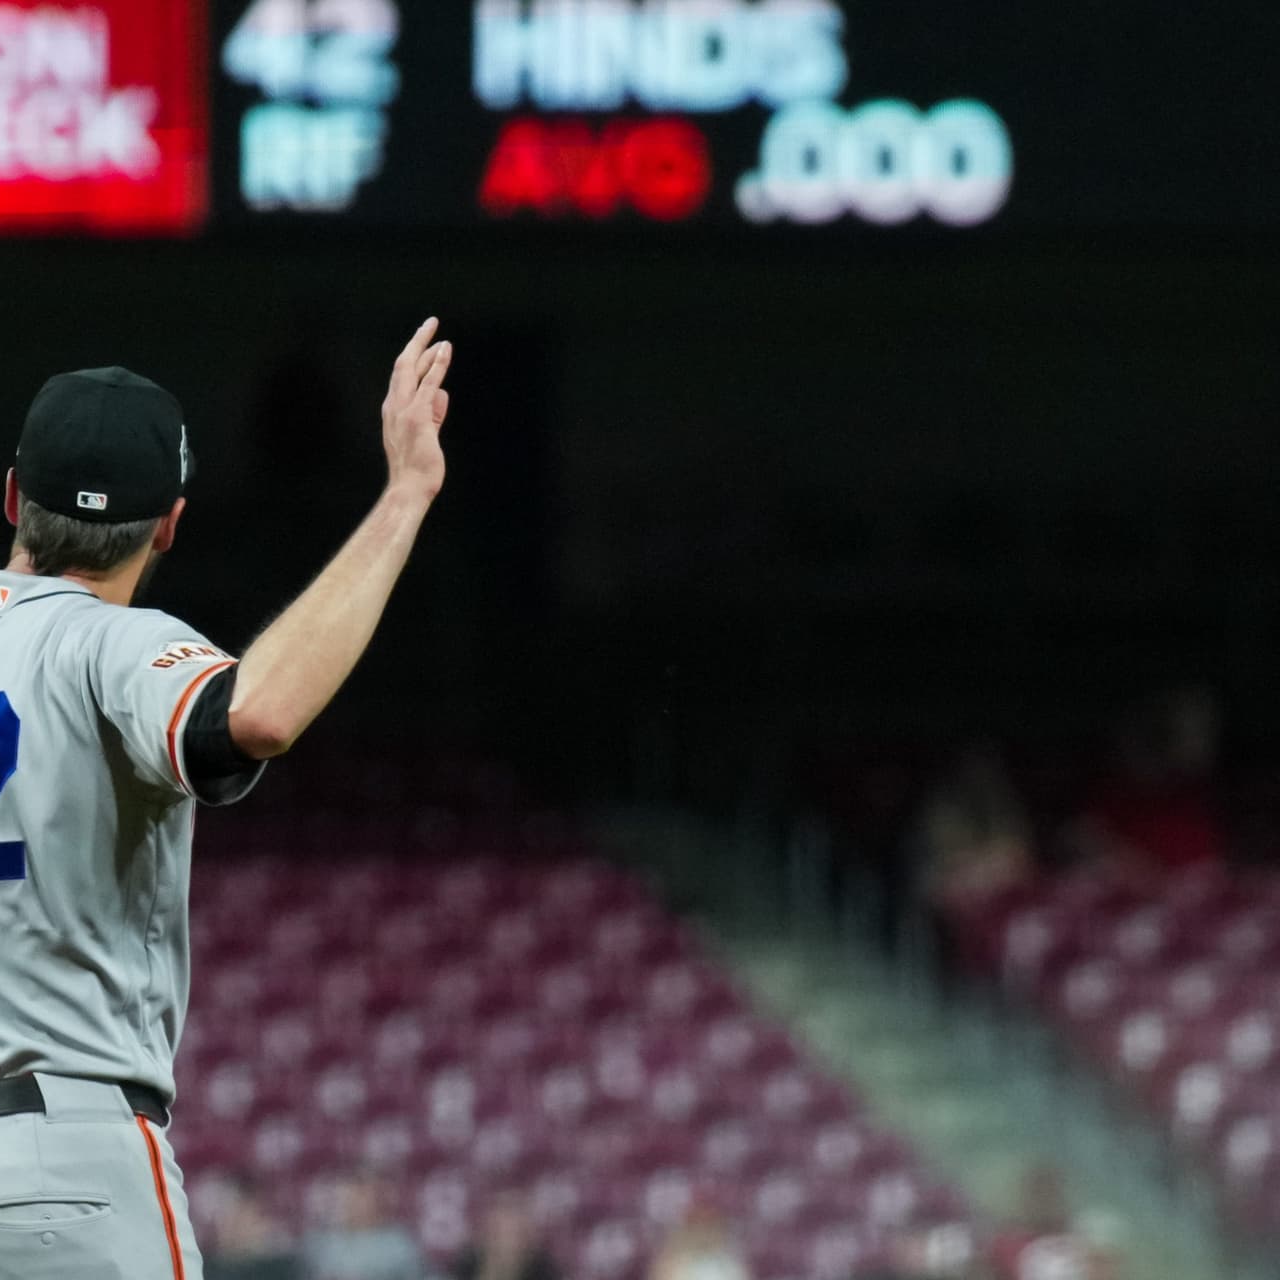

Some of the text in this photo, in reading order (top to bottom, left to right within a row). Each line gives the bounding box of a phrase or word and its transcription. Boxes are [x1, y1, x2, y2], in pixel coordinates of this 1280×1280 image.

[224, 0, 846, 112] 42 HINDS
[241, 102, 386, 211] RF
[480, 100, 1012, 225] AVG .000
[151, 646, 228, 668] GIAN
